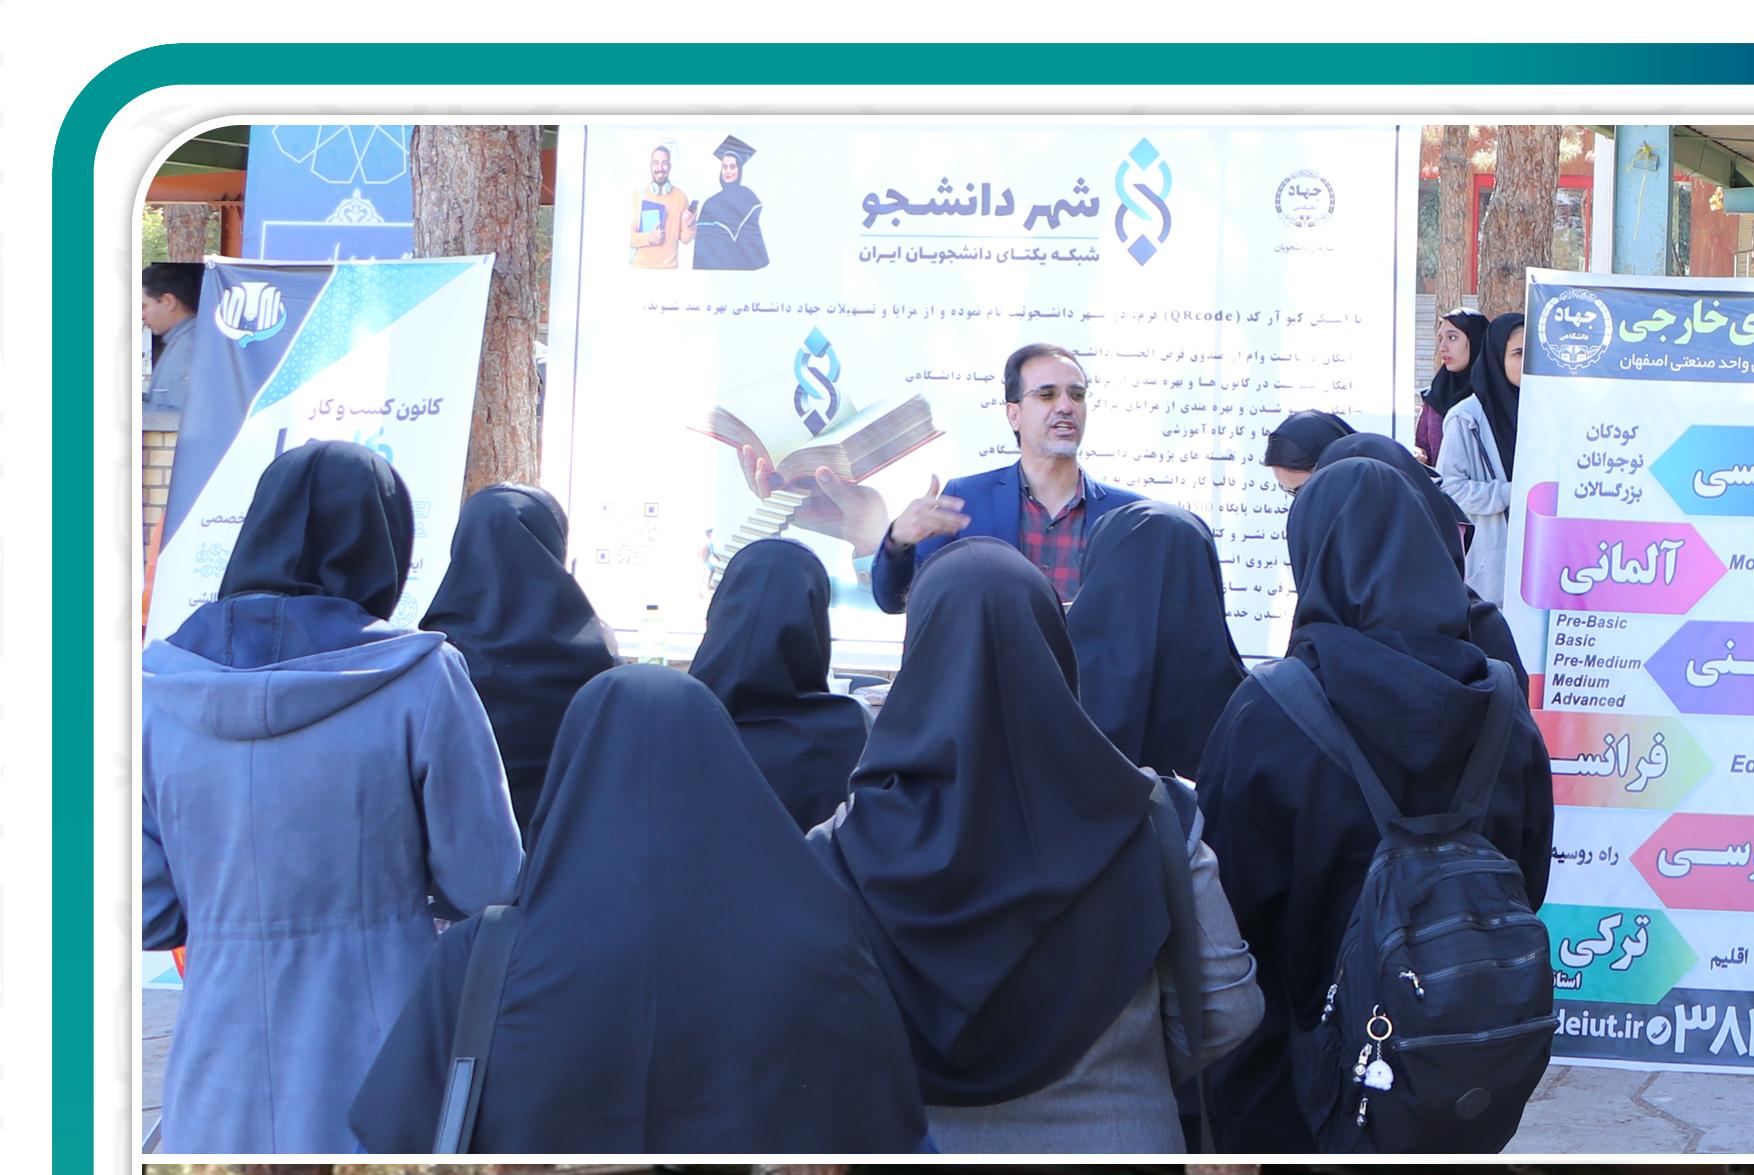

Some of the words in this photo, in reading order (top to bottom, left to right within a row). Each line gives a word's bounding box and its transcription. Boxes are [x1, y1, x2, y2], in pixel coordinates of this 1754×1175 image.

[1288, 183, 1322, 203] جهاد
[861, 176, 1015, 232] دانشجو
[1023, 177, 1100, 231] شهر
[859, 246, 901, 264] ایران
[905, 246, 992, 265] دانشجویان
[996, 246, 1047, 265] یکتای
[1051, 245, 1100, 266] شبکه
[1554, 305, 1598, 331] جهاد
[1619, 298, 1729, 345] خارجی
[1620, 353, 1668, 371] اصفهان
[1670, 354, 1714, 373] صنعتی
[1715, 357, 1750, 373] واحد
[396, 397, 443, 421] کانون
[1585, 422, 1639, 442] کودکان
[1576, 449, 1644, 475] نوجوانان
[1574, 480, 1643, 505] بزرگسالان
[200, 510, 246, 528] خصصی
[1559, 537, 1685, 596] آلمانی
[1555, 612, 1628, 631] Pre-Basic
[1554, 632, 1597, 649] Basic
[1553, 653, 1642, 672] Pre-Medium
[1551, 673, 1610, 690] Medium
[1551, 692, 1626, 709] Advanced
[1550, 732, 1670, 792] فرانس
[1598, 848, 1620, 865] راه
[1559, 913, 1652, 972] ترکی
[1710, 948, 1749, 970] اقلیم
